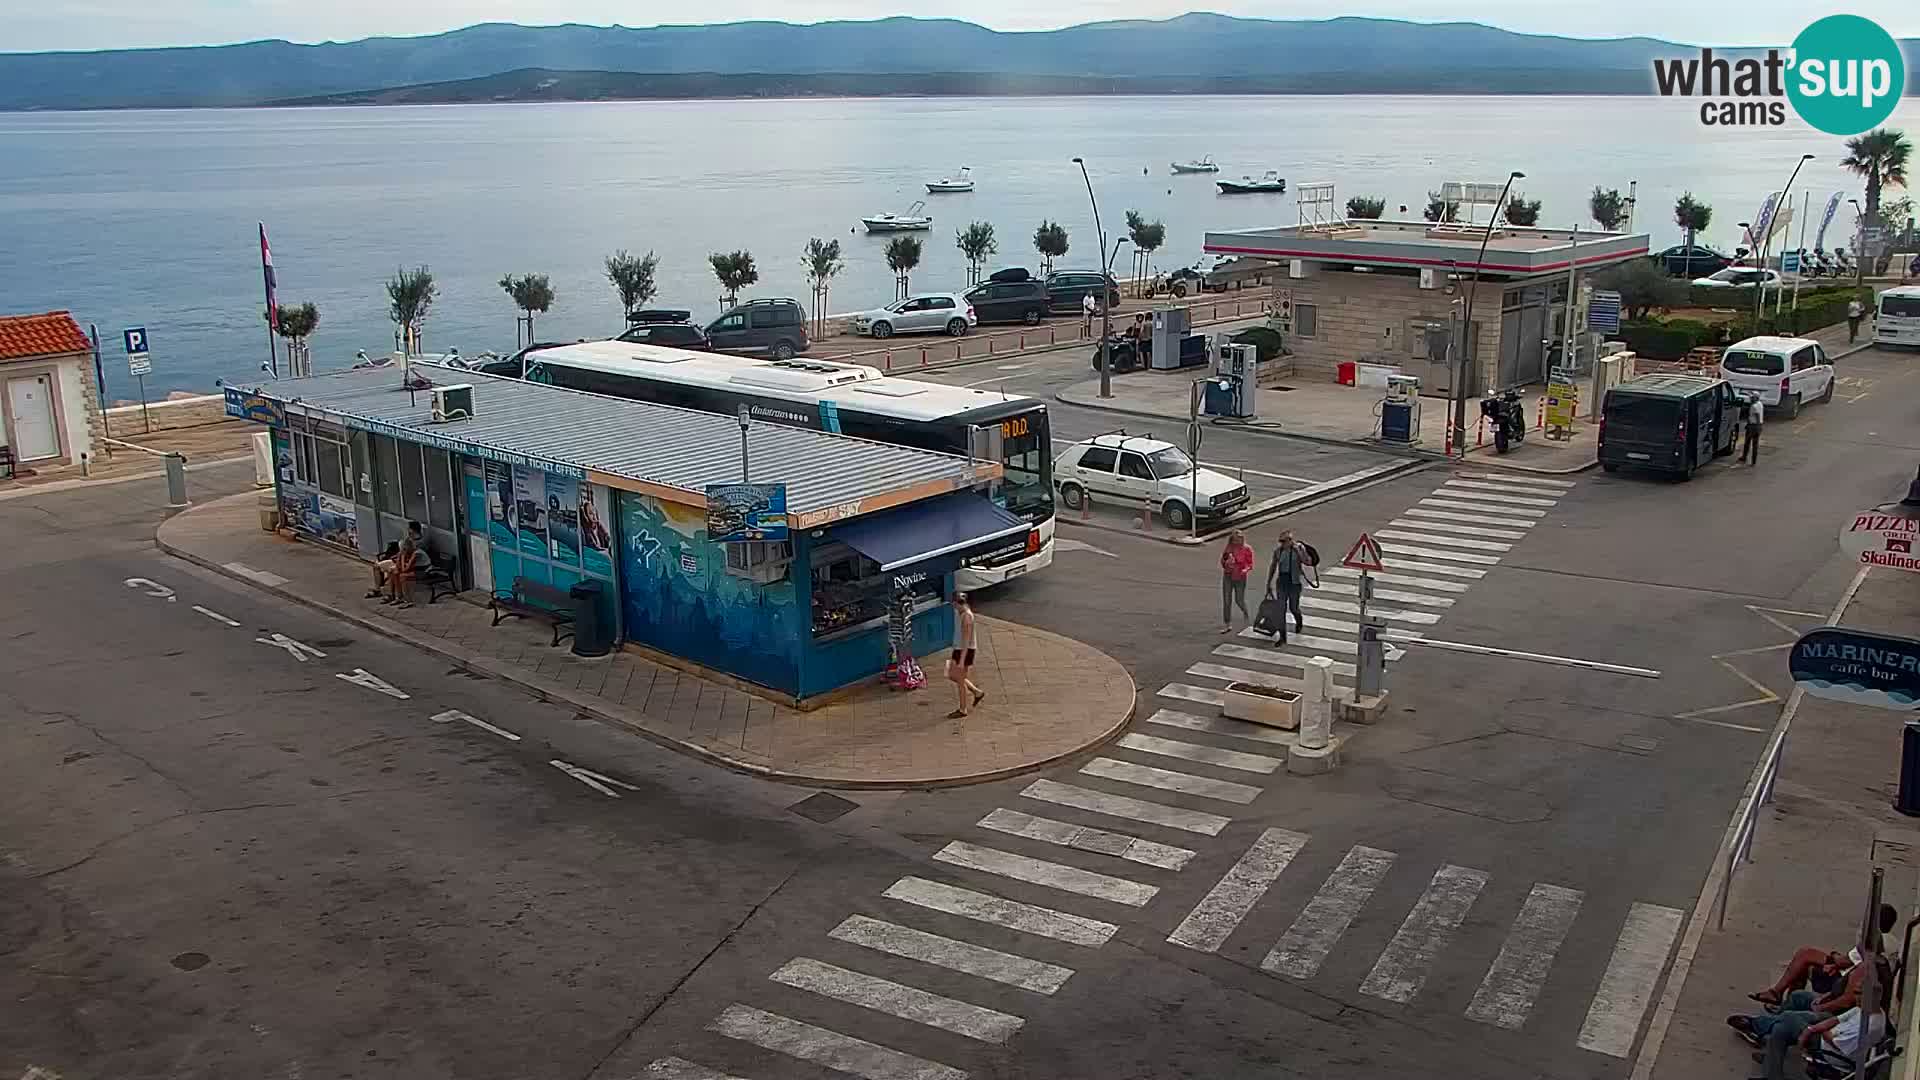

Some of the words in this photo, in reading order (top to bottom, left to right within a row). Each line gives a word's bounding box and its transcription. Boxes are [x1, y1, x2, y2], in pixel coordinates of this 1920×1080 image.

[129, 332, 142, 351] P
[1746, 352, 1765, 360] TAXI
[478, 446, 493, 459] BUS
[494, 450, 526, 467] STATION
[528, 458, 554, 474] TICKET
[555, 464, 582, 479] OFFICE
[1849, 516, 1920, 534] PIZZE
[893, 571, 927, 589] Novine
[1830, 663, 1867, 675] caffe
[1871, 666, 1899, 680] bar
